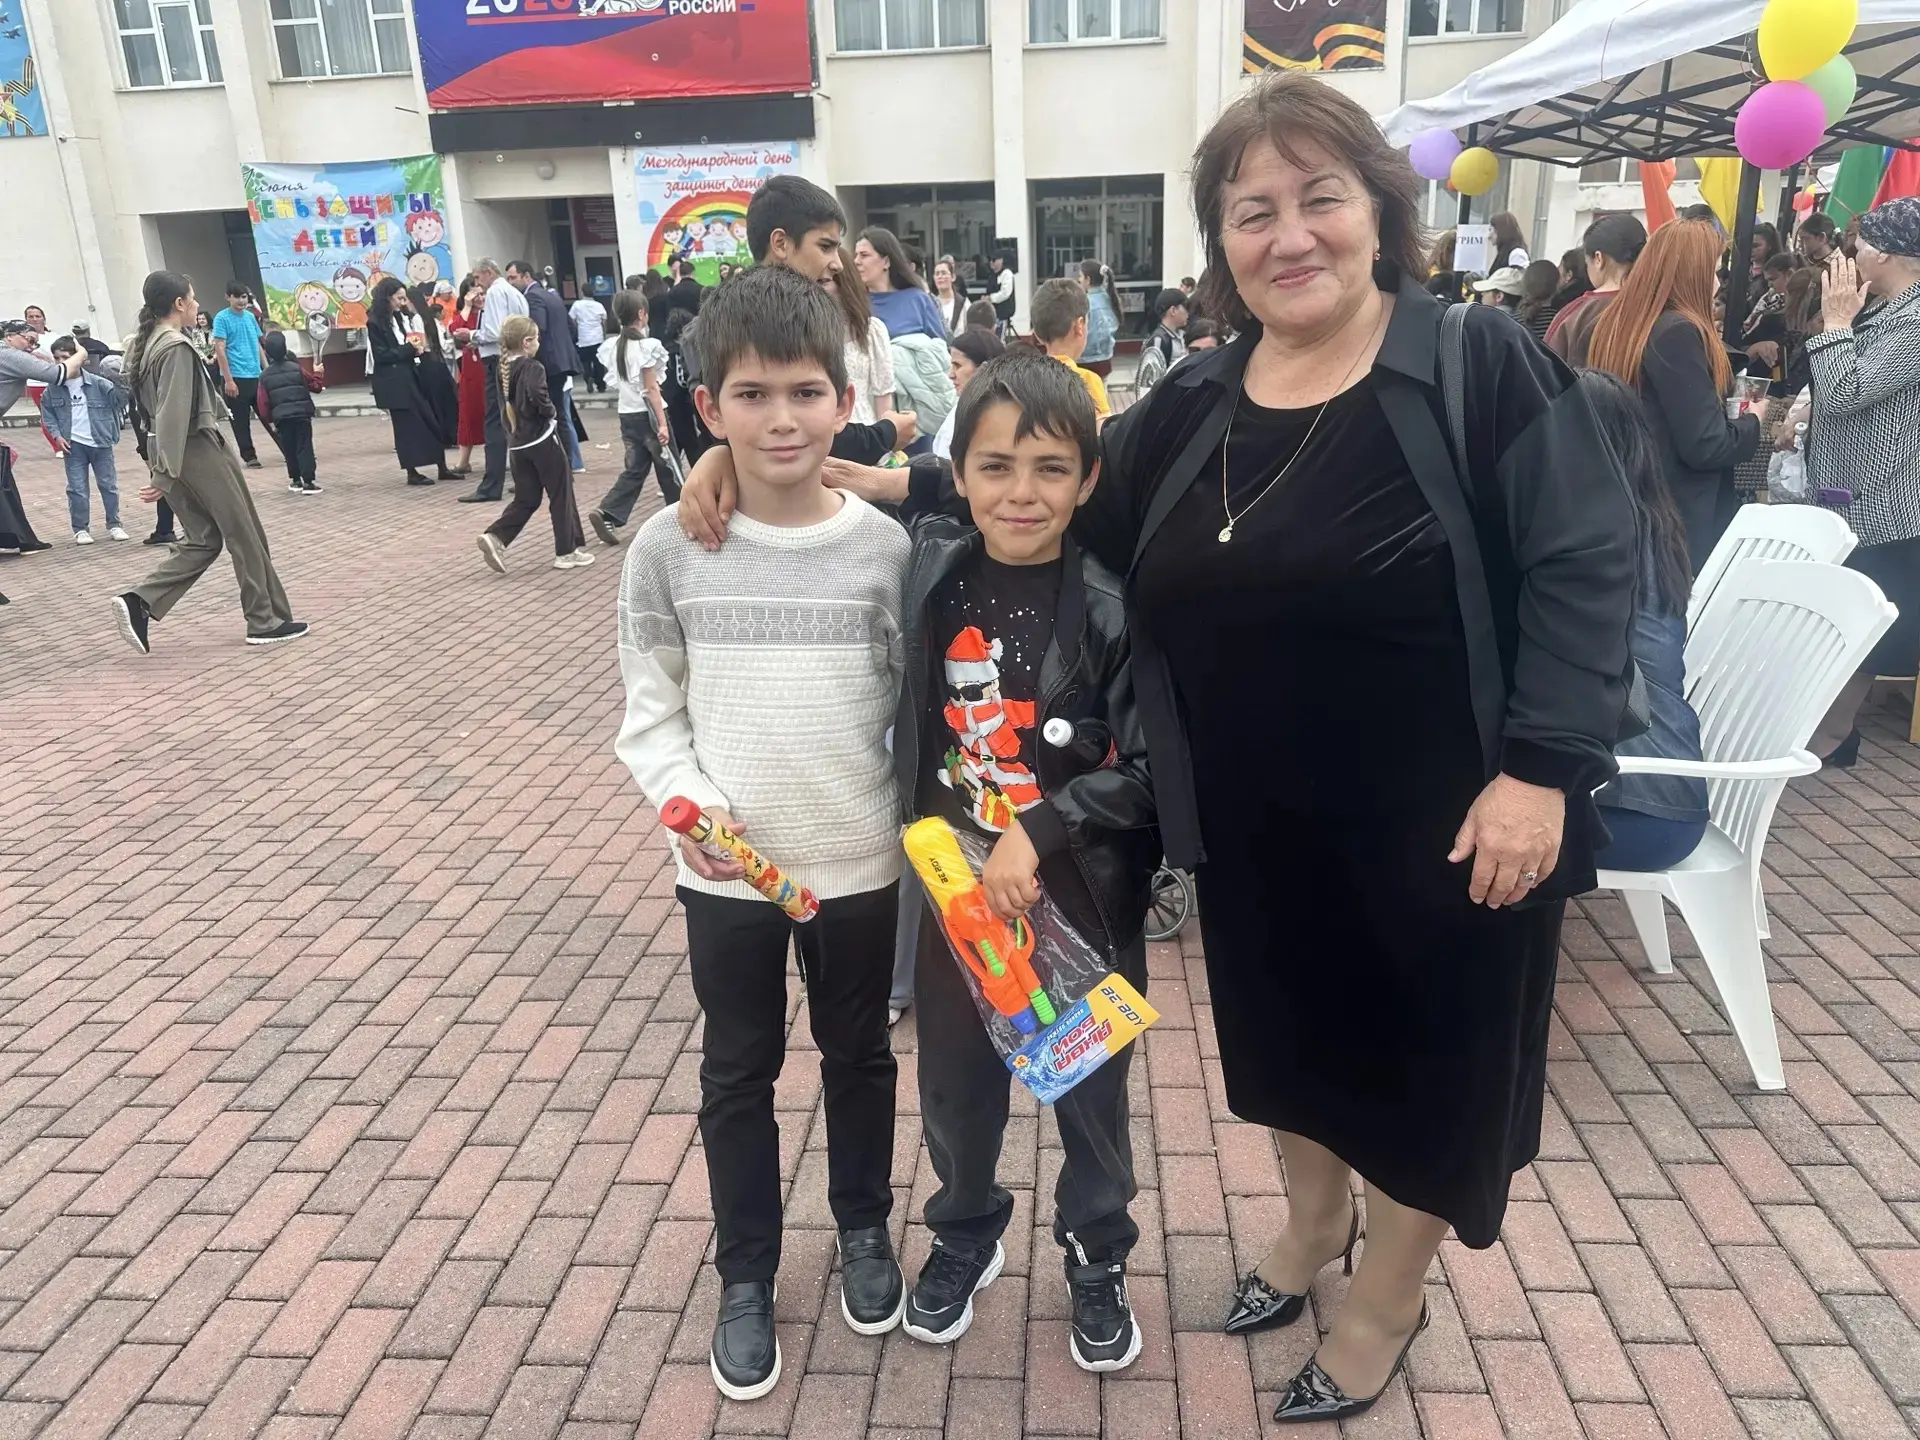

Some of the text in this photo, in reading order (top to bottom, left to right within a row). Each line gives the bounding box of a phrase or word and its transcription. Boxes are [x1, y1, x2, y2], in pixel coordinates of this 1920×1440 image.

[668, 0, 737, 15] РОССИИ
[642, 150, 792, 174] Международный день
[255, 182, 308, 192] июня
[664, 175, 766, 198] защиты дете
[315, 192, 432, 220] ЗАЩИТЫ
[1101, 986, 1146, 1026] BE BOY
[1054, 1019, 1113, 1072] АКВА
